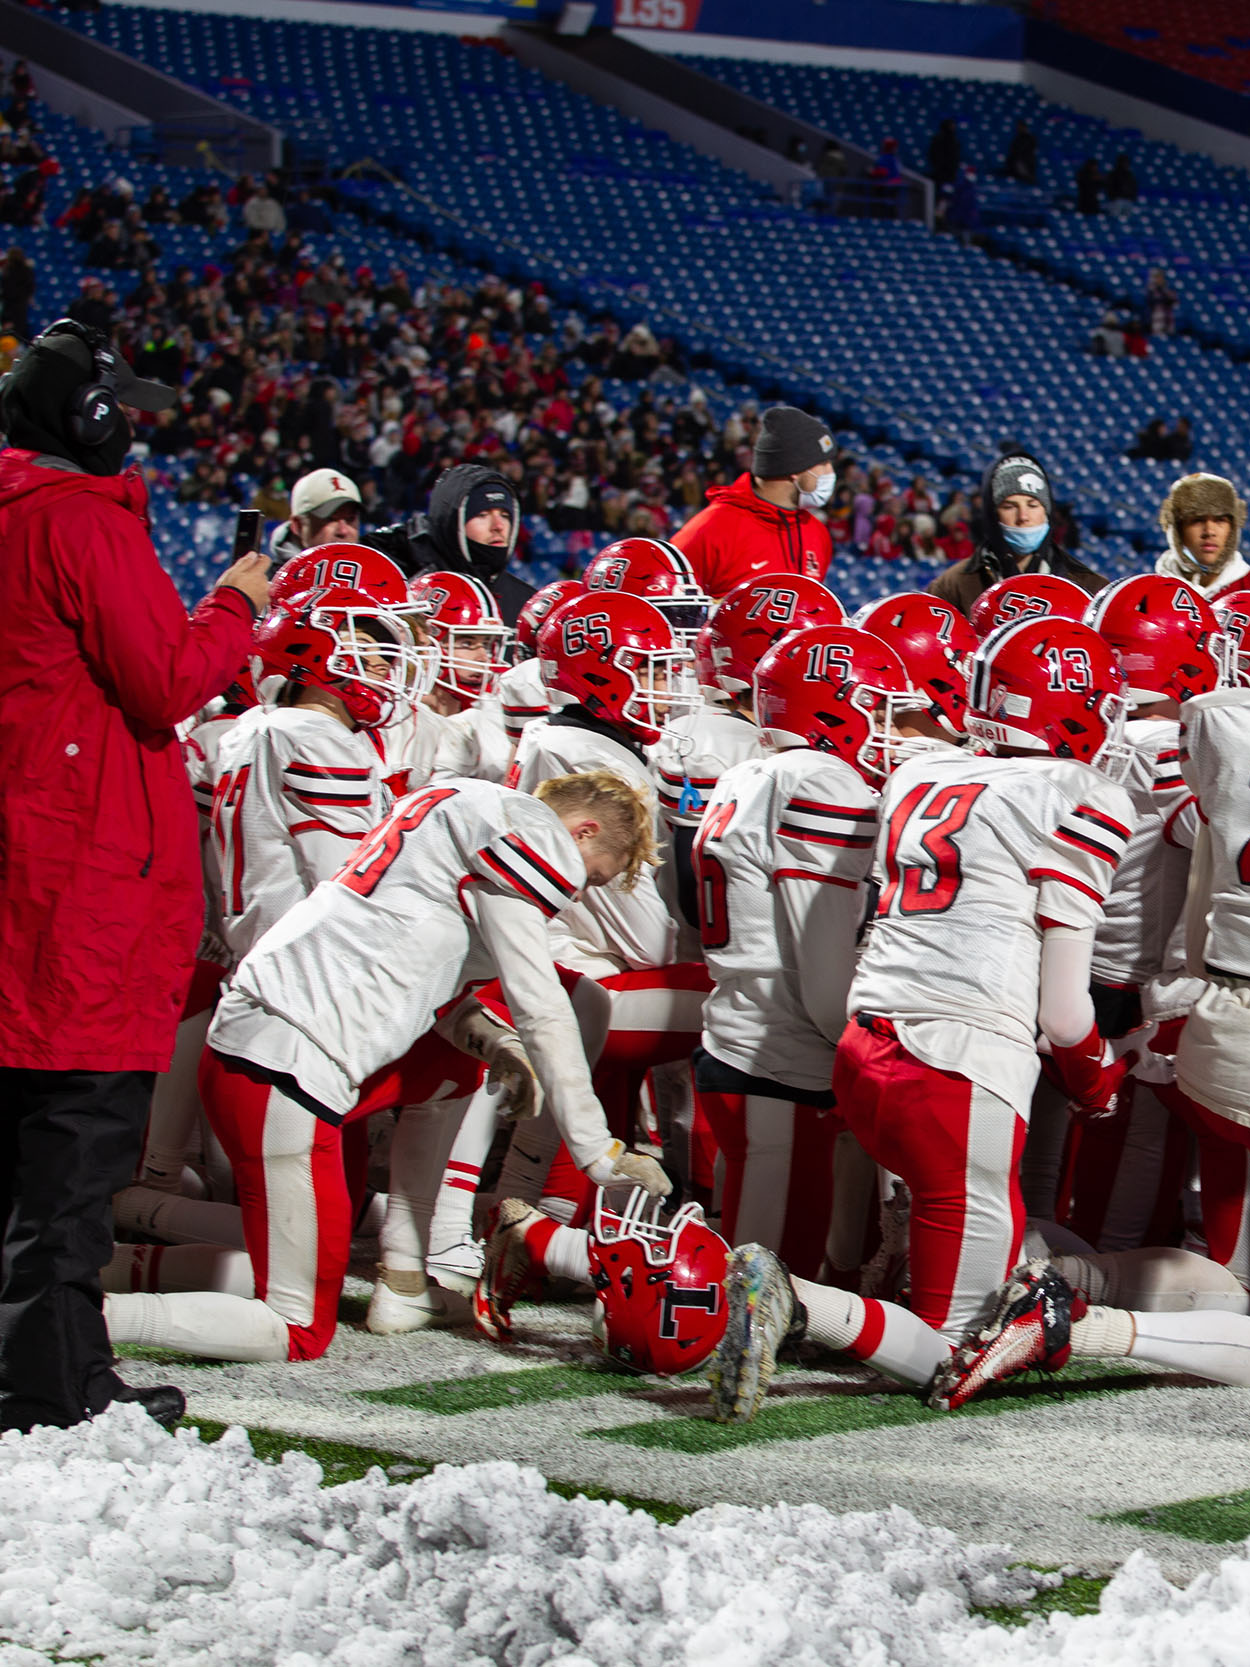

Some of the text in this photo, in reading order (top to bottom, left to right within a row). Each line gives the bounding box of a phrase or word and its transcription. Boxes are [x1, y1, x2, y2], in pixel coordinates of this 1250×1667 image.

[314, 559, 362, 590] 19
[587, 557, 631, 591] 63
[746, 587, 799, 624] 79
[992, 591, 1053, 627] 52
[1171, 588, 1202, 622] 4
[928, 606, 955, 643] 7
[803, 643, 854, 684] 16
[1045, 648, 1093, 693] 13
[873, 781, 989, 917] 13
[658, 1280, 719, 1339] L
